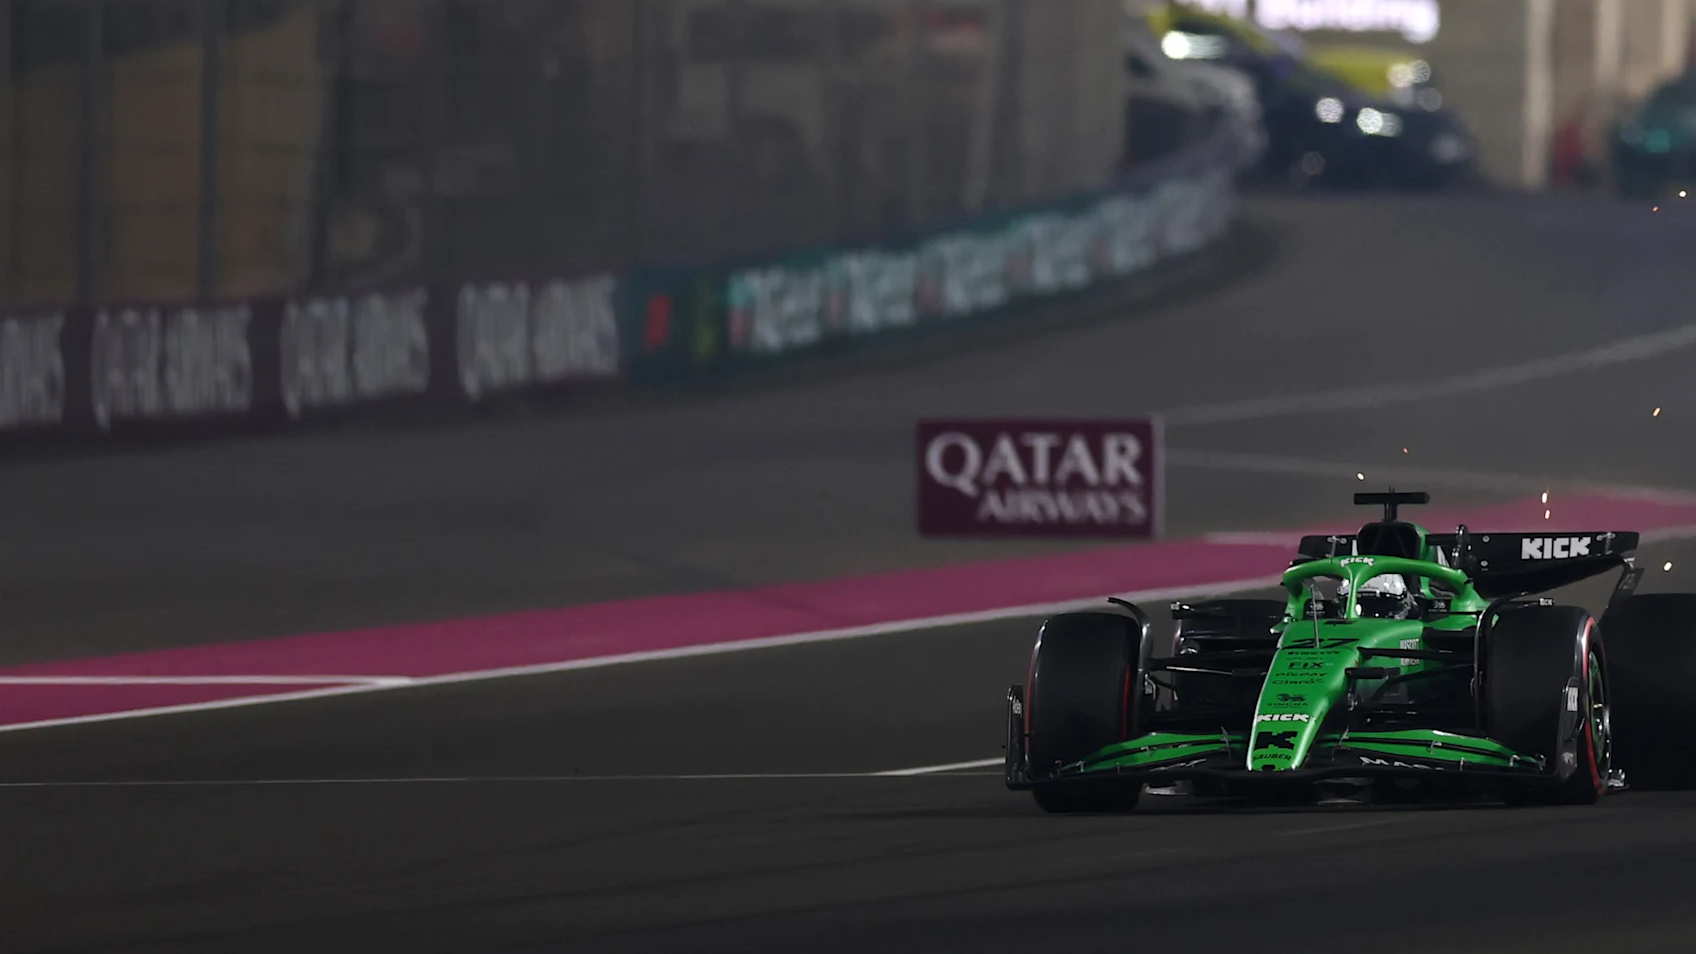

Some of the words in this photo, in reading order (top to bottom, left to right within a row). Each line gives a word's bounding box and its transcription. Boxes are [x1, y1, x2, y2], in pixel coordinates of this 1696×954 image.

[925, 432, 1145, 496] QATAR
[977, 490, 1148, 525] AIRWAYS
[1521, 536, 1592, 560] KICK
[1340, 556, 1375, 567] KICK
[1280, 638, 1361, 650] 27
[1256, 713, 1310, 723] KICK
[1253, 752, 1292, 761] SAUBER
